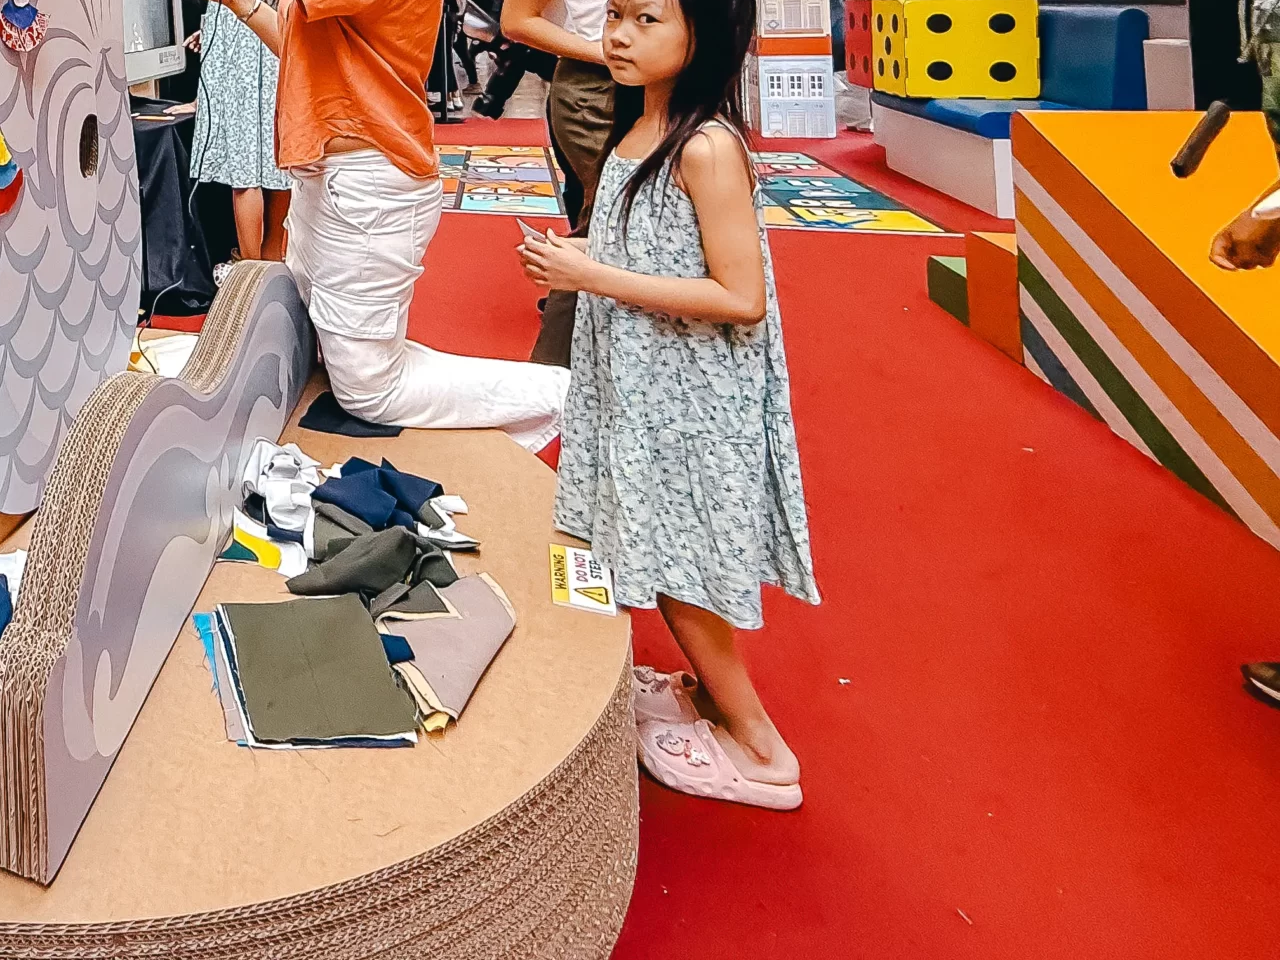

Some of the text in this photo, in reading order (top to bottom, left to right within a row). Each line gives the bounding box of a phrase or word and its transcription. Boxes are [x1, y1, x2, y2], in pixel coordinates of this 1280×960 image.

[553, 553, 566, 590] WARNING
[573, 551, 588, 583] DO NOT
[589, 559, 603, 580] STEP
